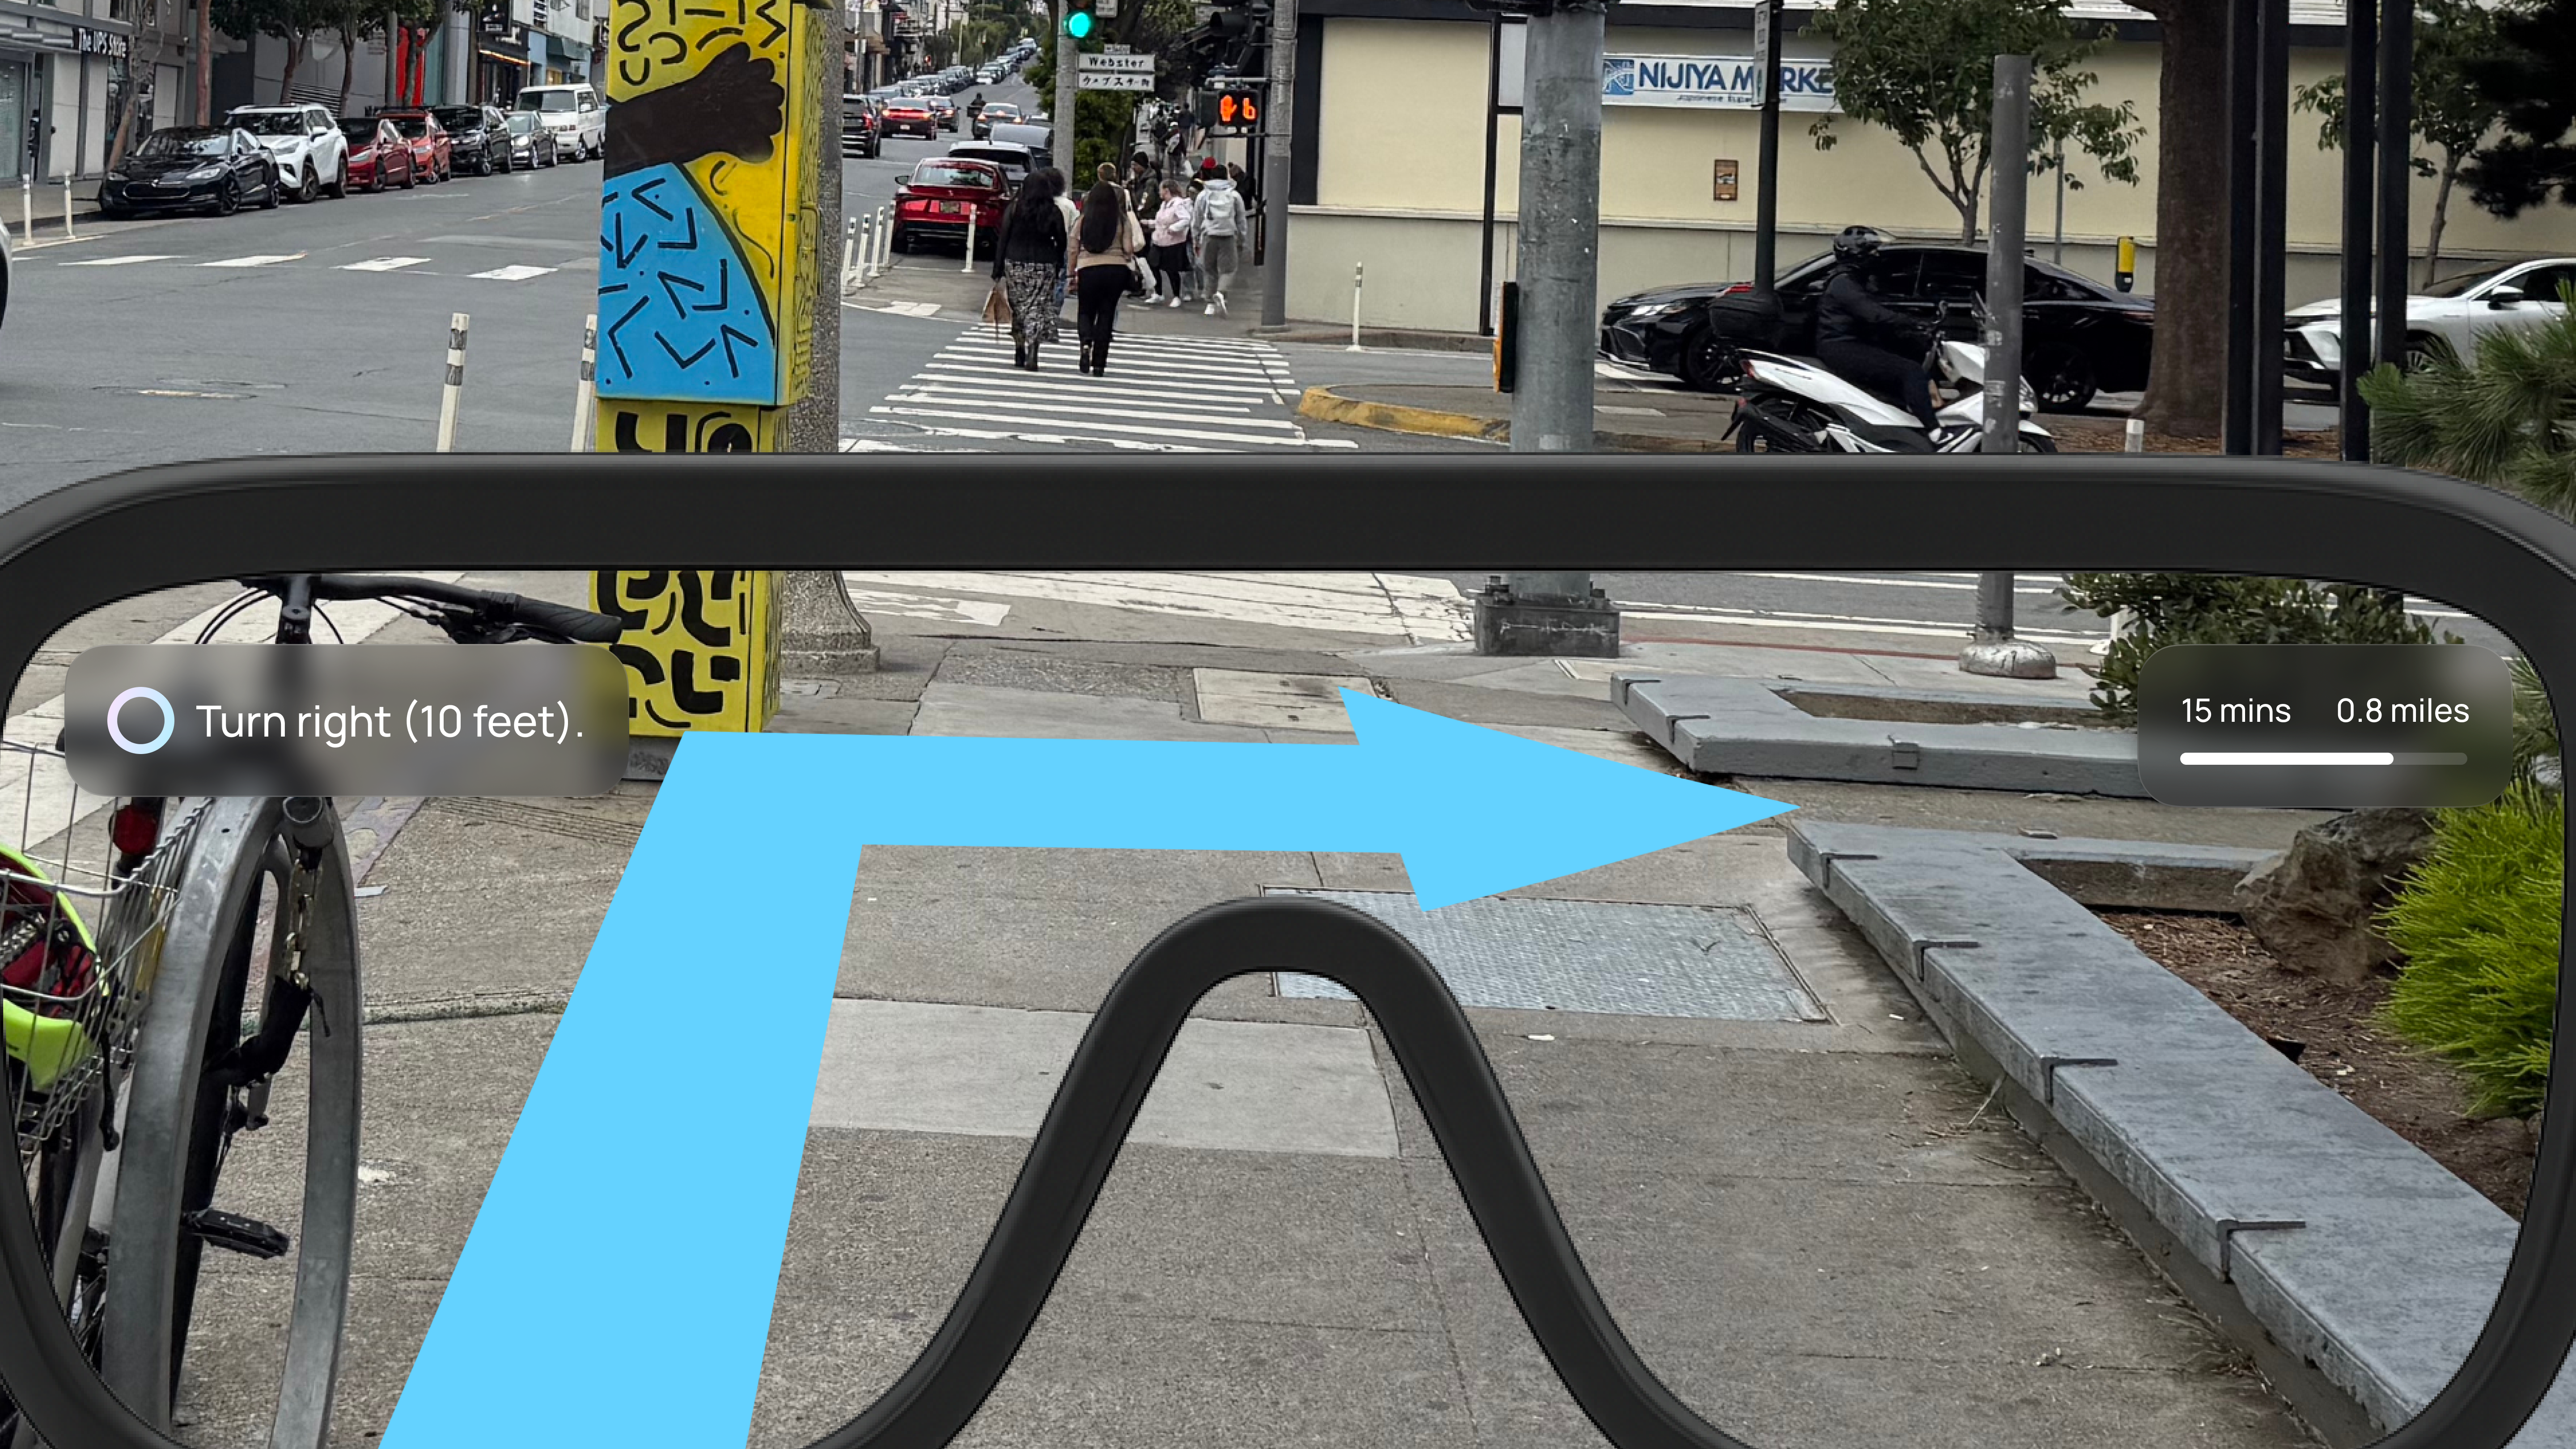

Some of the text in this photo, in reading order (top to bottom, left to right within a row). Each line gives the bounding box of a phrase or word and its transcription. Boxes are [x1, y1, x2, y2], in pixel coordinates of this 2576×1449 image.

[79, 28, 127, 58] The UPS Store
[1089, 57, 1144, 67] Webster
[1639, 62, 1834, 93] NIJIYA MRKE
